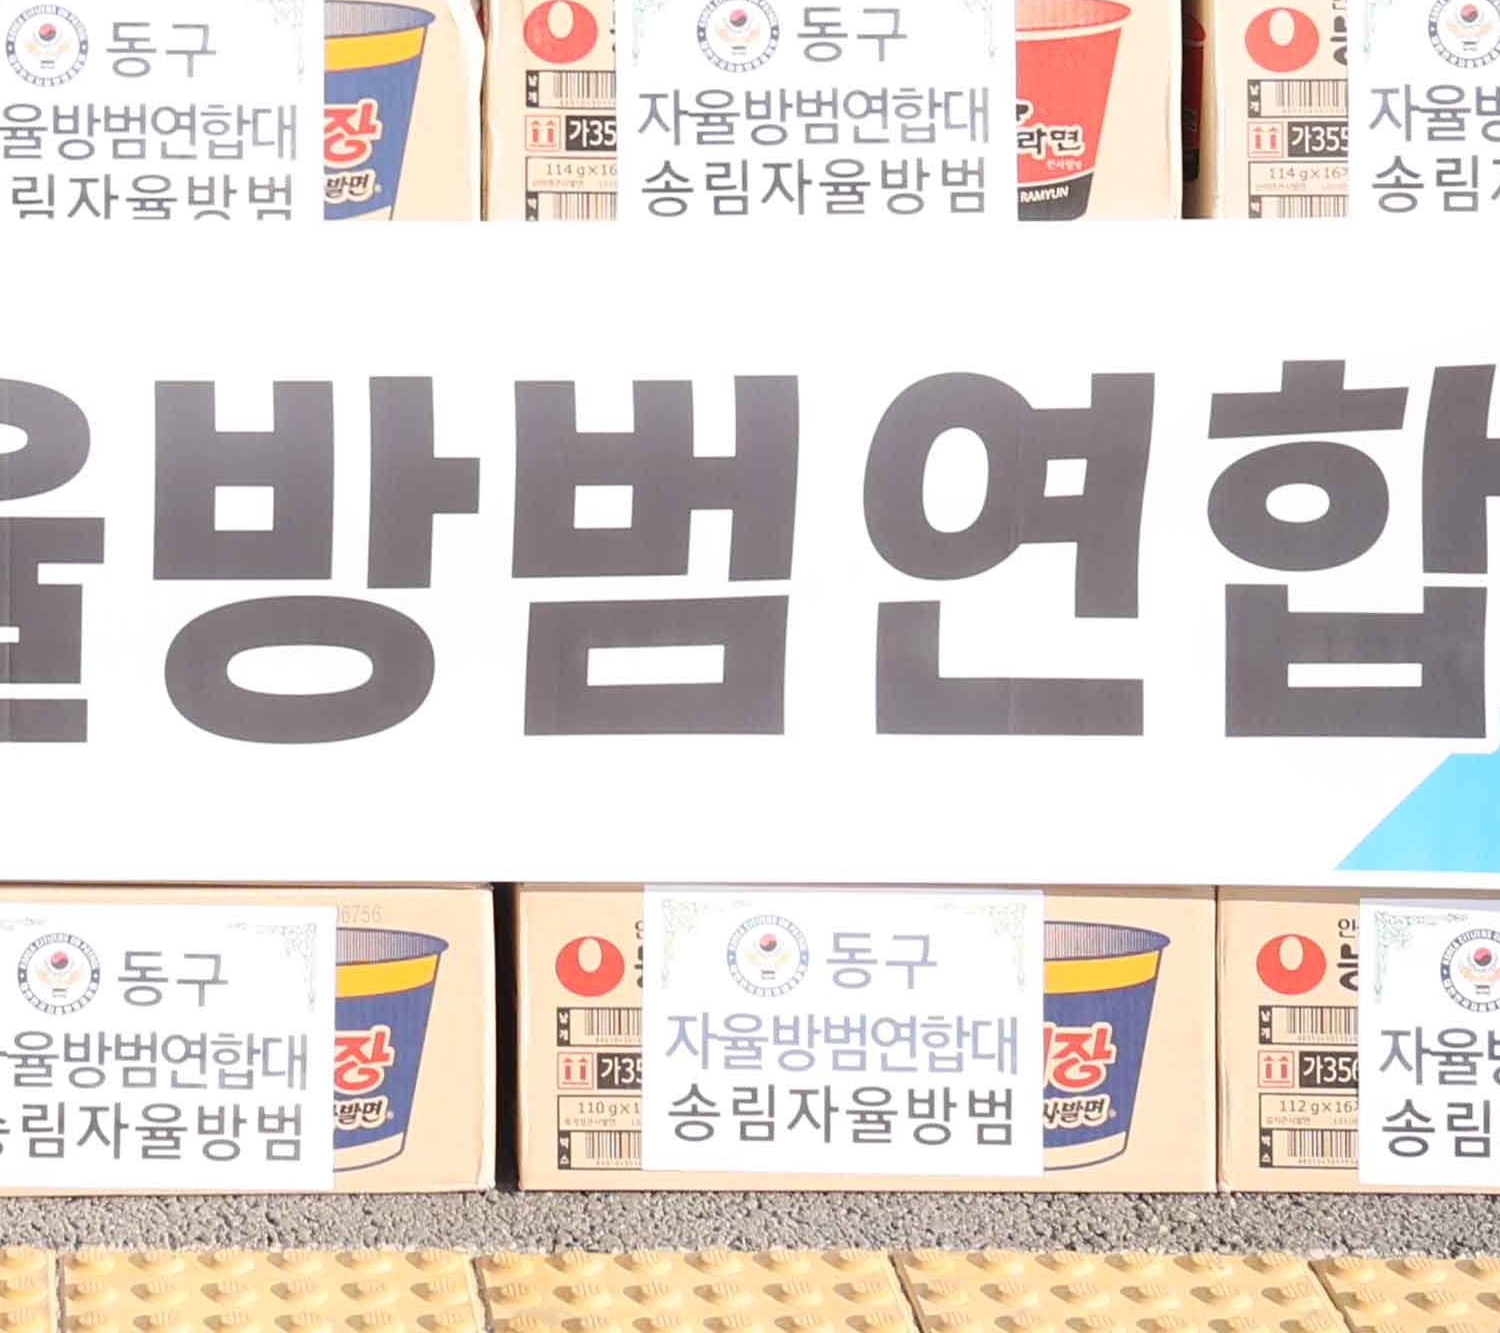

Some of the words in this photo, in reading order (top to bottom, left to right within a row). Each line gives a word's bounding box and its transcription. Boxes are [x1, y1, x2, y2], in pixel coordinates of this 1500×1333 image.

[106, 21, 218, 79] 동구
[797, 7, 908, 64] 동구
[638, 88, 990, 146] 자율방범연합대
[642, 157, 986, 218] 송림자율방범
[1020, 187, 1070, 204] RAMYUN
[117, 951, 229, 1007] 동구
[826, 933, 938, 990] 동구
[665, 1013, 1019, 1075] 자율방범연합대
[668, 1083, 1013, 1146] 송림자율방범
